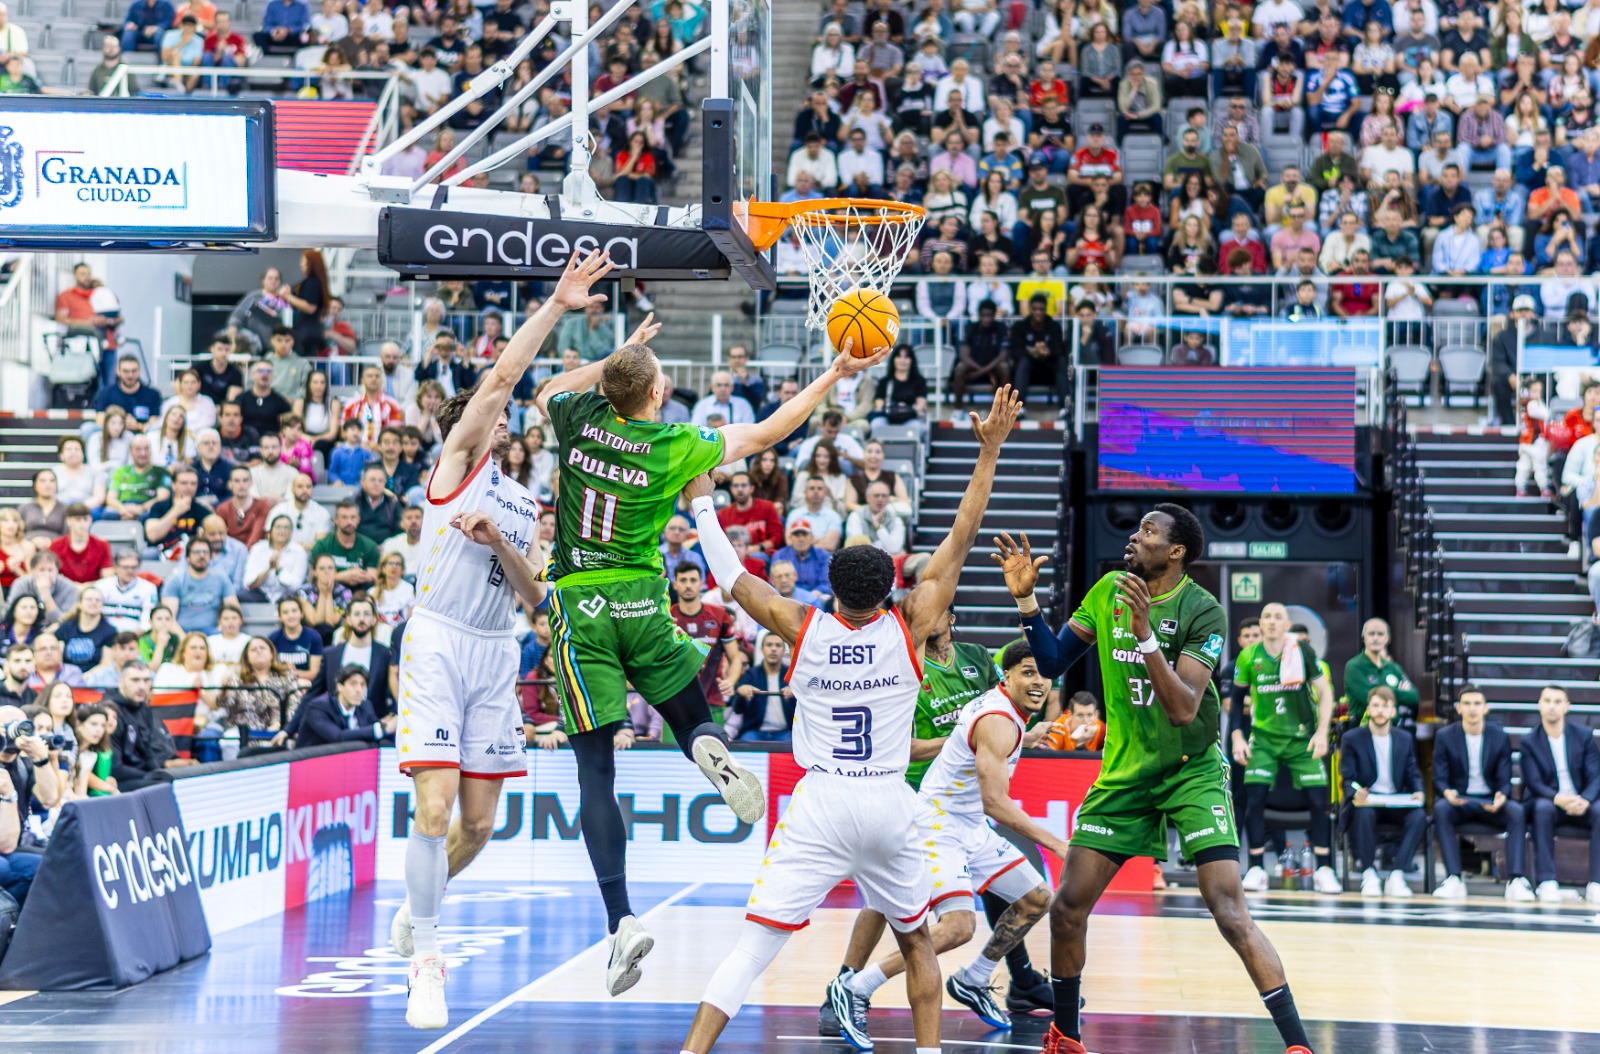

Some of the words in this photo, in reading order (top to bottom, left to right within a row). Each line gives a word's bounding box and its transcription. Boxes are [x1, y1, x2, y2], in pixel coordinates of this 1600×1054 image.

[41, 157, 180, 186] GRANADA
[77, 187, 151, 202] CIUDAD
[424, 221, 638, 269] endesa
[568, 447, 649, 487] PULEVA
[580, 485, 618, 543] 11
[609, 598, 655, 611] Diputación
[610, 610, 620, 619] de
[829, 644, 876, 665] BEST
[820, 675, 899, 691] MORABANC
[1128, 677, 1155, 707] 37
[1274, 697, 1287, 715] 2
[831, 706, 873, 762] 3
[1081, 823, 1106, 835] asisa
[92, 819, 192, 909] endesa
